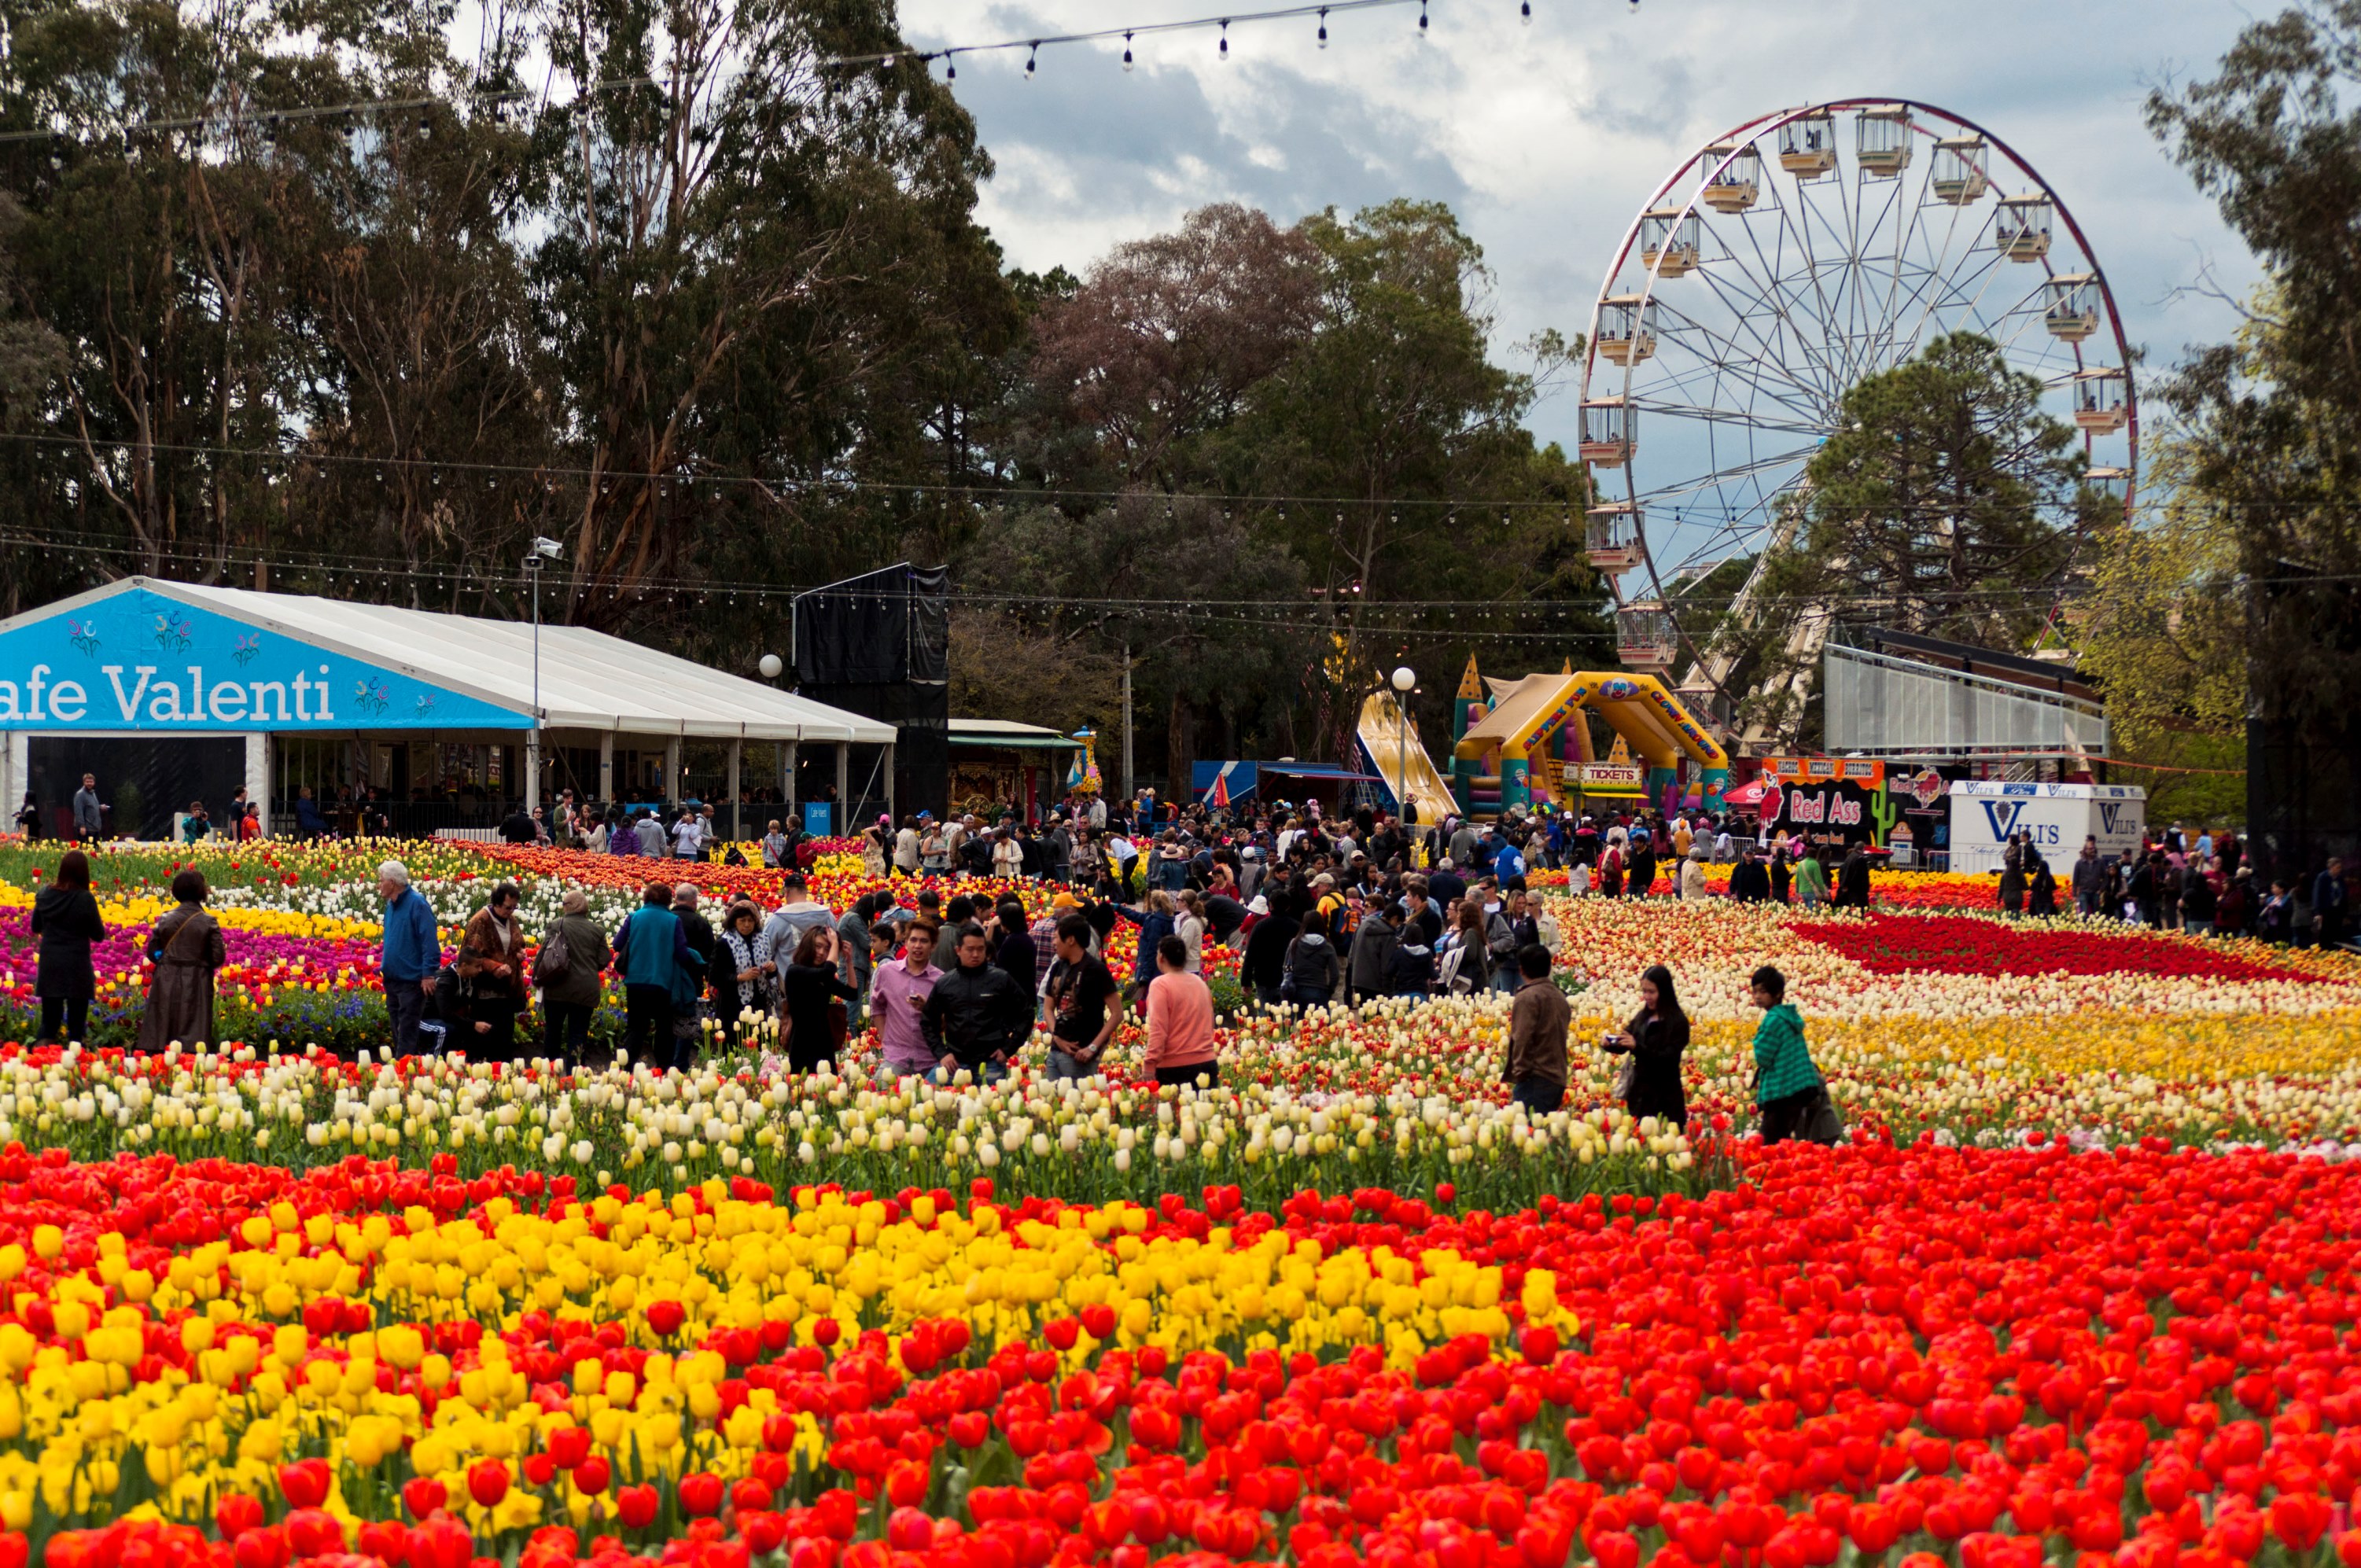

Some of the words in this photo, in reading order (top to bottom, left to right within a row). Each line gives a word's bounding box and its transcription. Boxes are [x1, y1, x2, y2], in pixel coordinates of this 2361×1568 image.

[101, 664, 335, 722] Valenti
[1650, 690, 1685, 722] CLOWN
[1678, 722, 1719, 760] AROUND
[1589, 769, 1634, 780] TICKETS
[1790, 790, 1825, 823] Red
[1828, 791, 1862, 825] Ass
